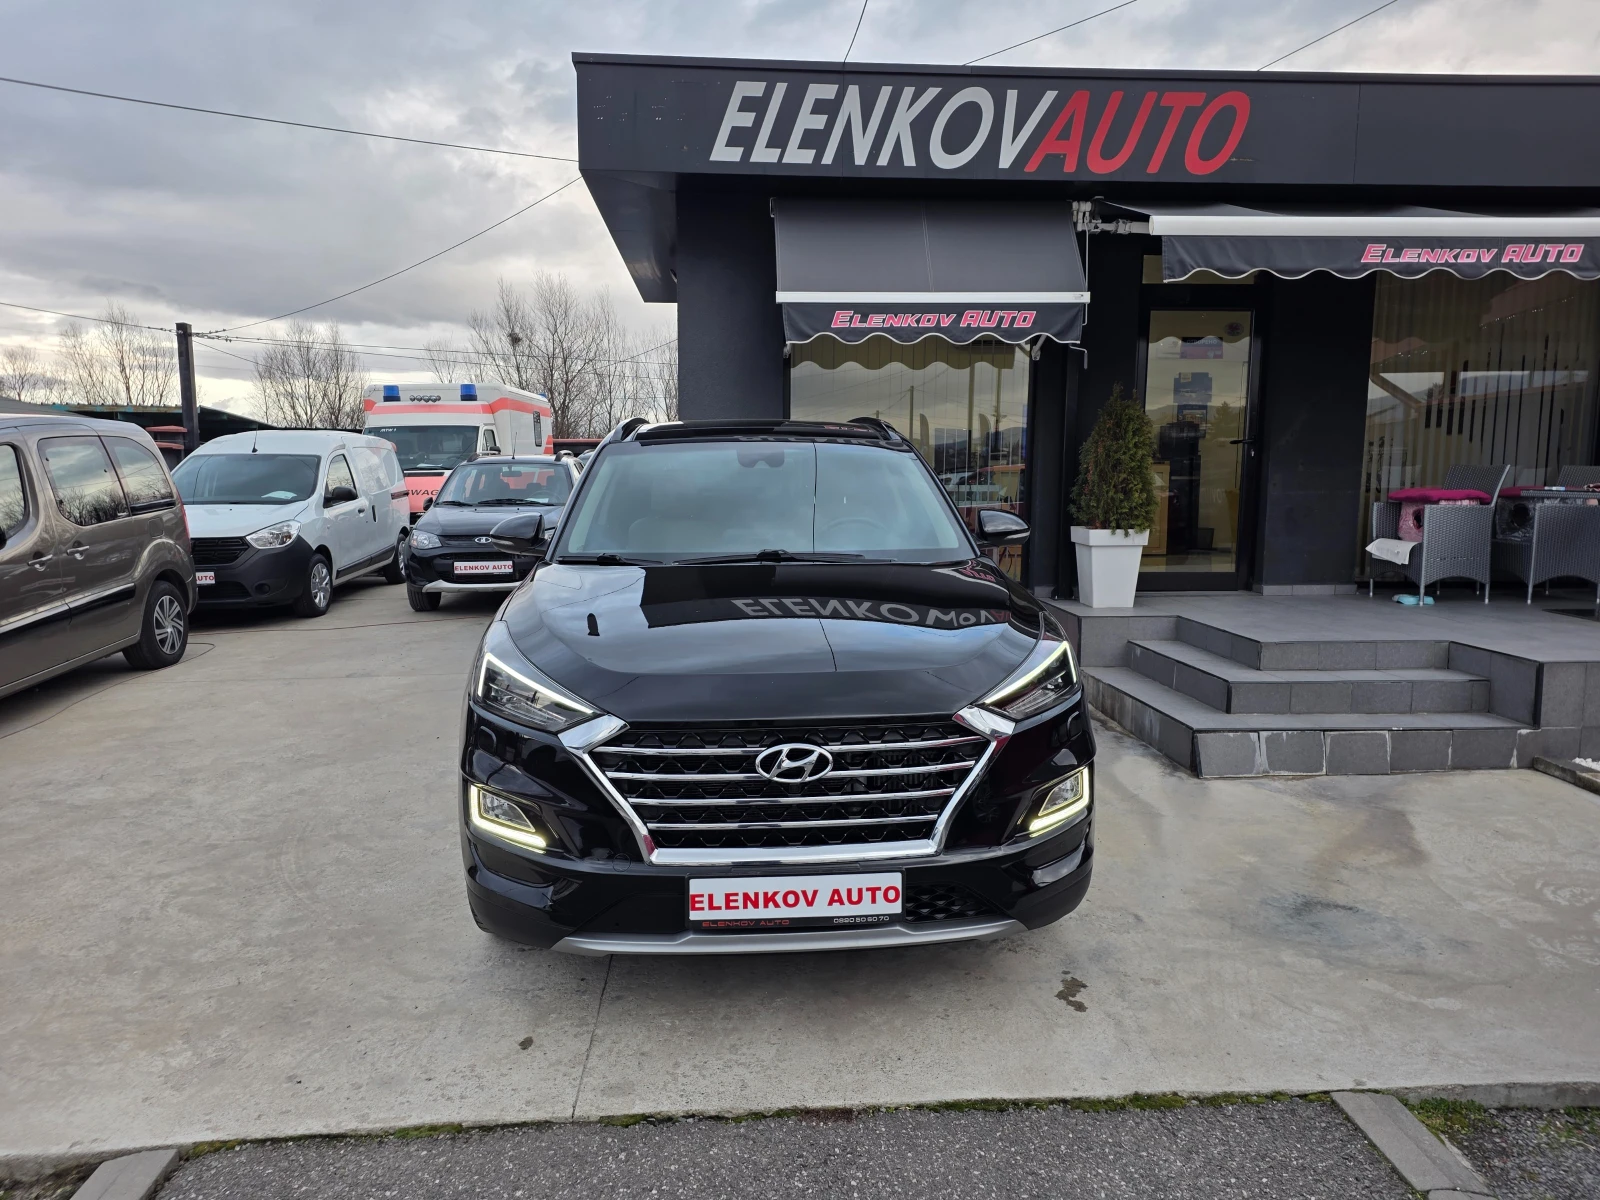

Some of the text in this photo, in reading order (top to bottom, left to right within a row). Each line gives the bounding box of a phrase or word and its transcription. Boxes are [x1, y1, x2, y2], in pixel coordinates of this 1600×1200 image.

[1361, 243, 1585, 264] ELENKOV AUTO
[831, 310, 1037, 329] ELENKOV AUTO
[690, 885, 900, 911] ELENKOV AUTO
